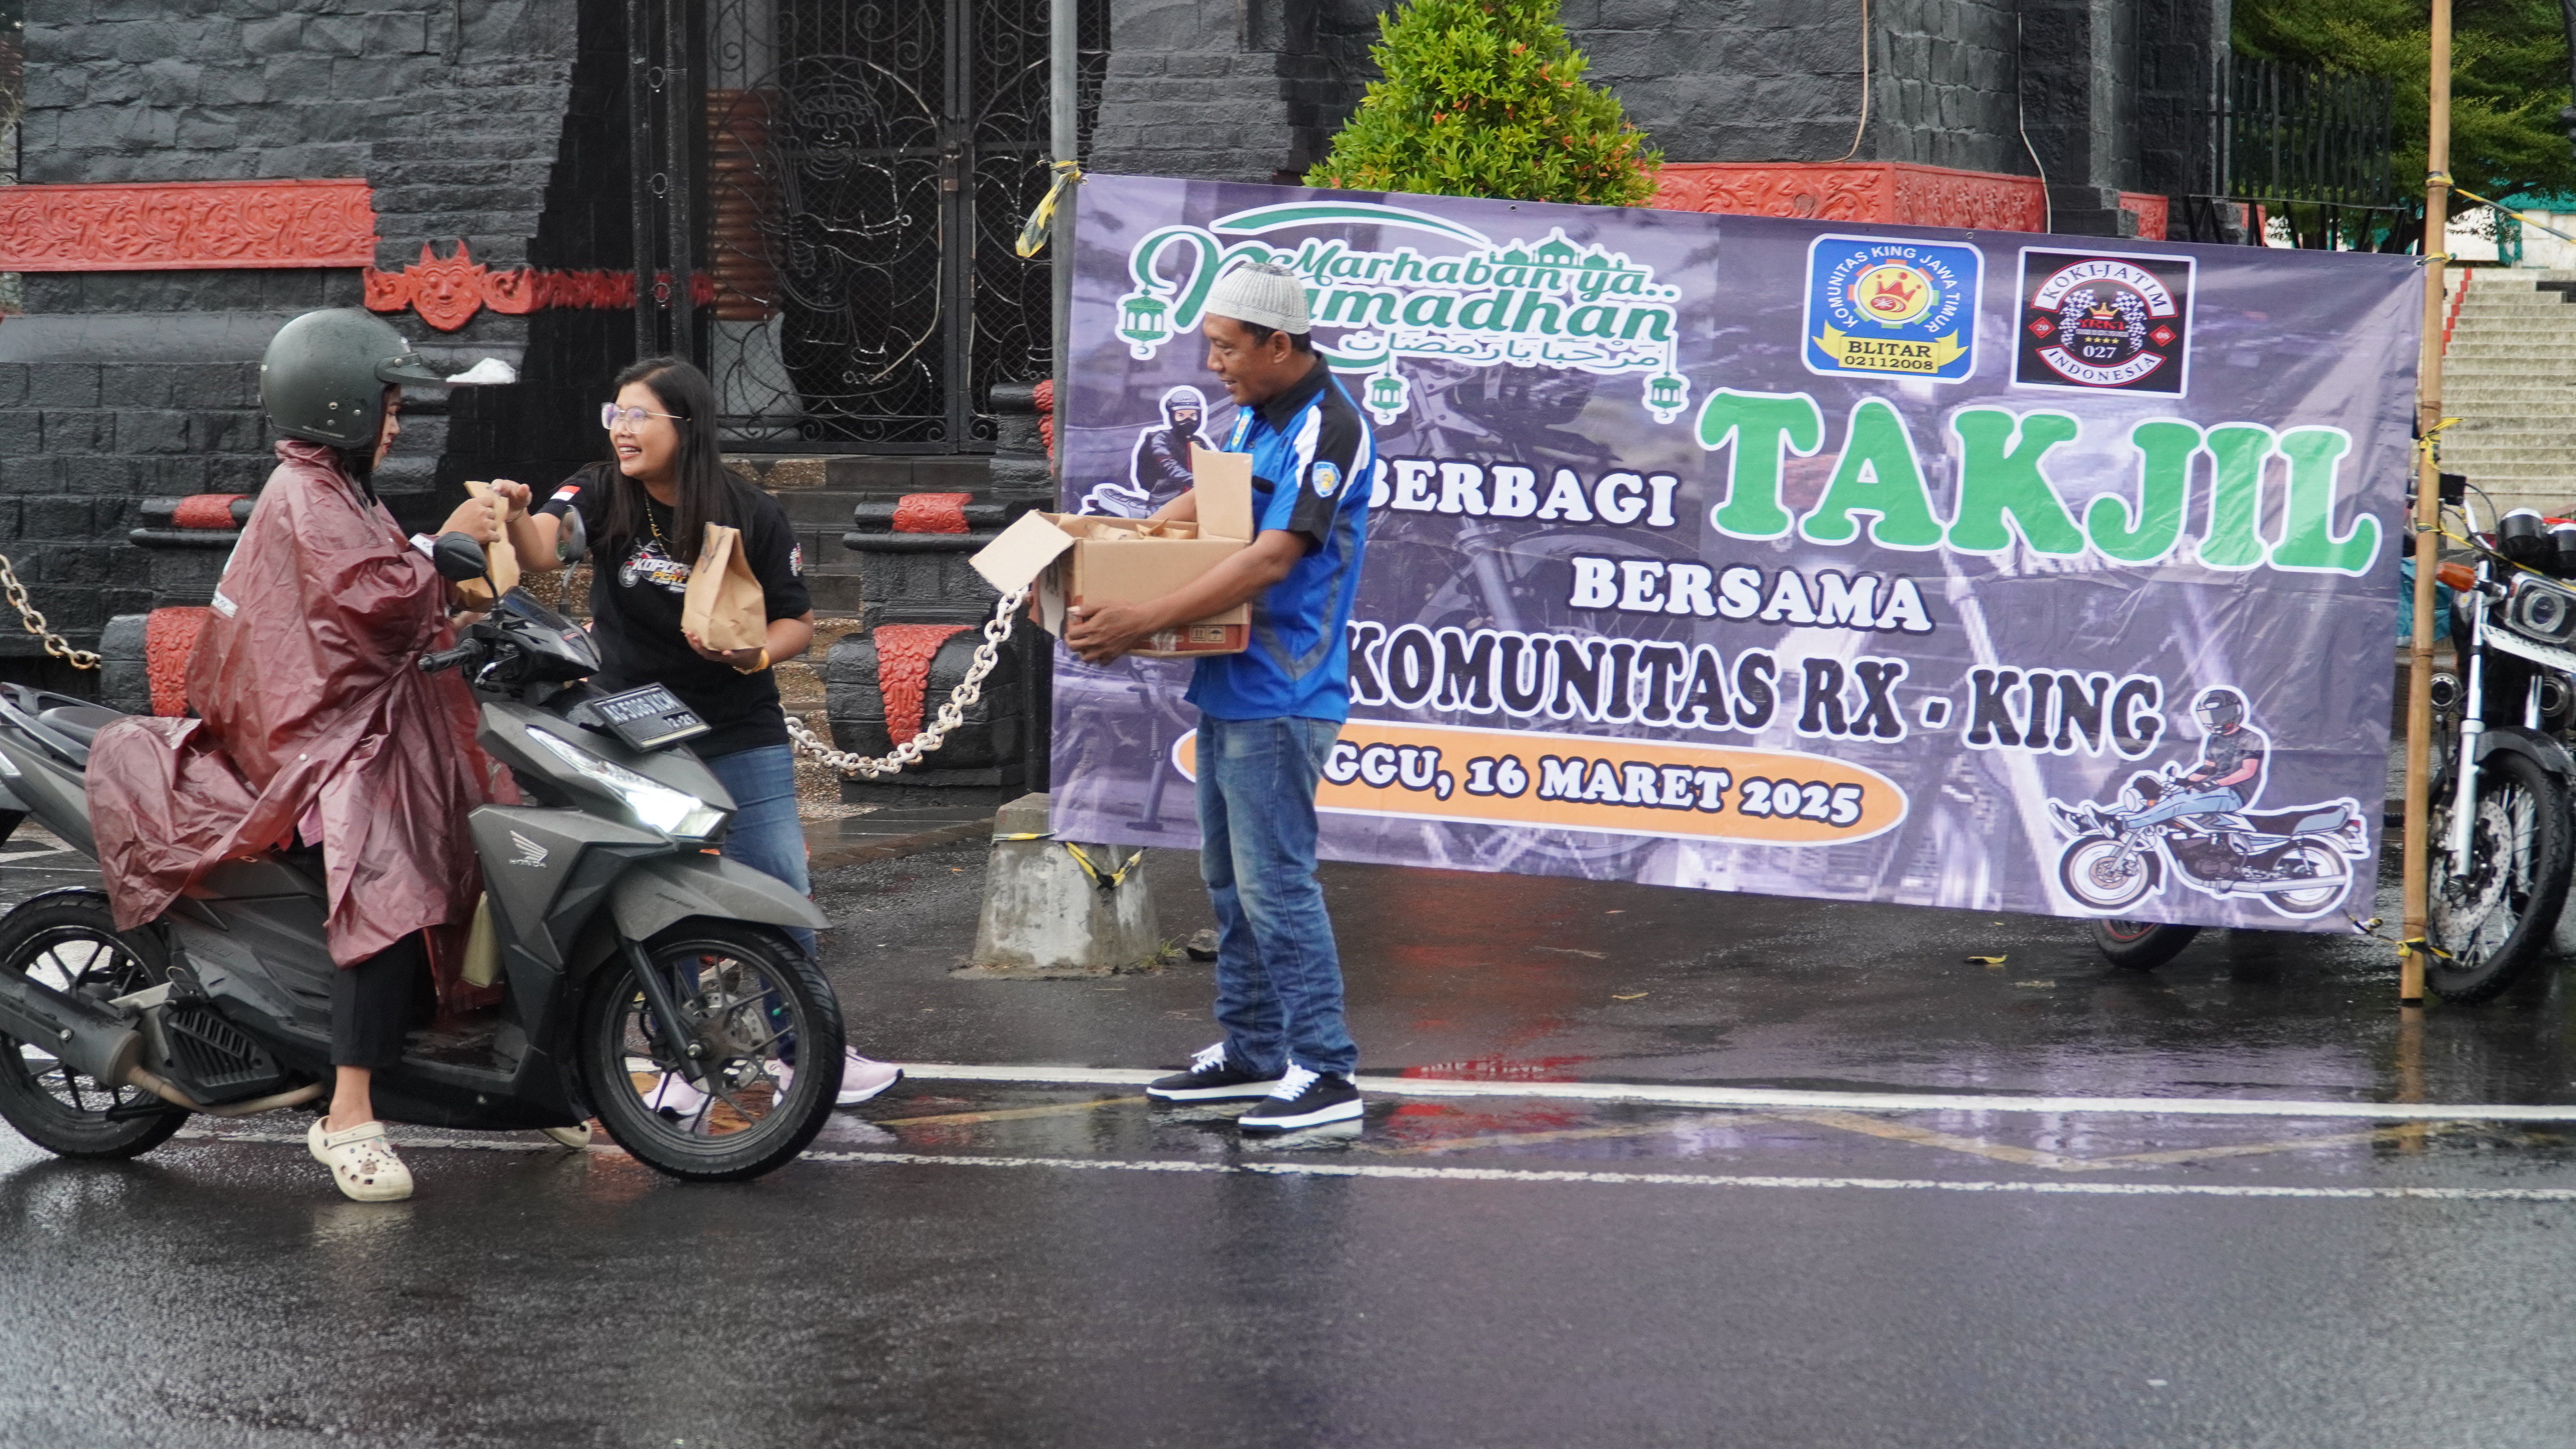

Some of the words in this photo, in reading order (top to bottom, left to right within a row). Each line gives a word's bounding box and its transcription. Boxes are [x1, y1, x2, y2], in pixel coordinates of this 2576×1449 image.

[1269, 244, 1563, 290] Marhaban
[1871, 246, 1917, 258] KING
[1827, 252, 1868, 328] KOMUNITAS
[1919, 255, 1958, 289] JAWA
[2042, 264, 2168, 307] KOKI-JATIM
[1924, 292, 1960, 333] TIMUR
[1848, 340, 1932, 358] BLITAR
[2083, 345, 2117, 358] 027
[2156, 332, 2171, 340] 08
[1844, 355, 1933, 370] 02112008
[2048, 350, 2156, 381] INDONESIA
[1697, 388, 2381, 576] TAKJIL
[1569, 557, 1933, 631] BERSAMA
[602, 705, 629, 722] AG
[1799, 657, 1905, 740] RX
[1966, 668, 2161, 756] KING
[1467, 759, 1527, 794] 16
[1540, 759, 1730, 809] MARET
[1742, 780, 1861, 824] 2025
